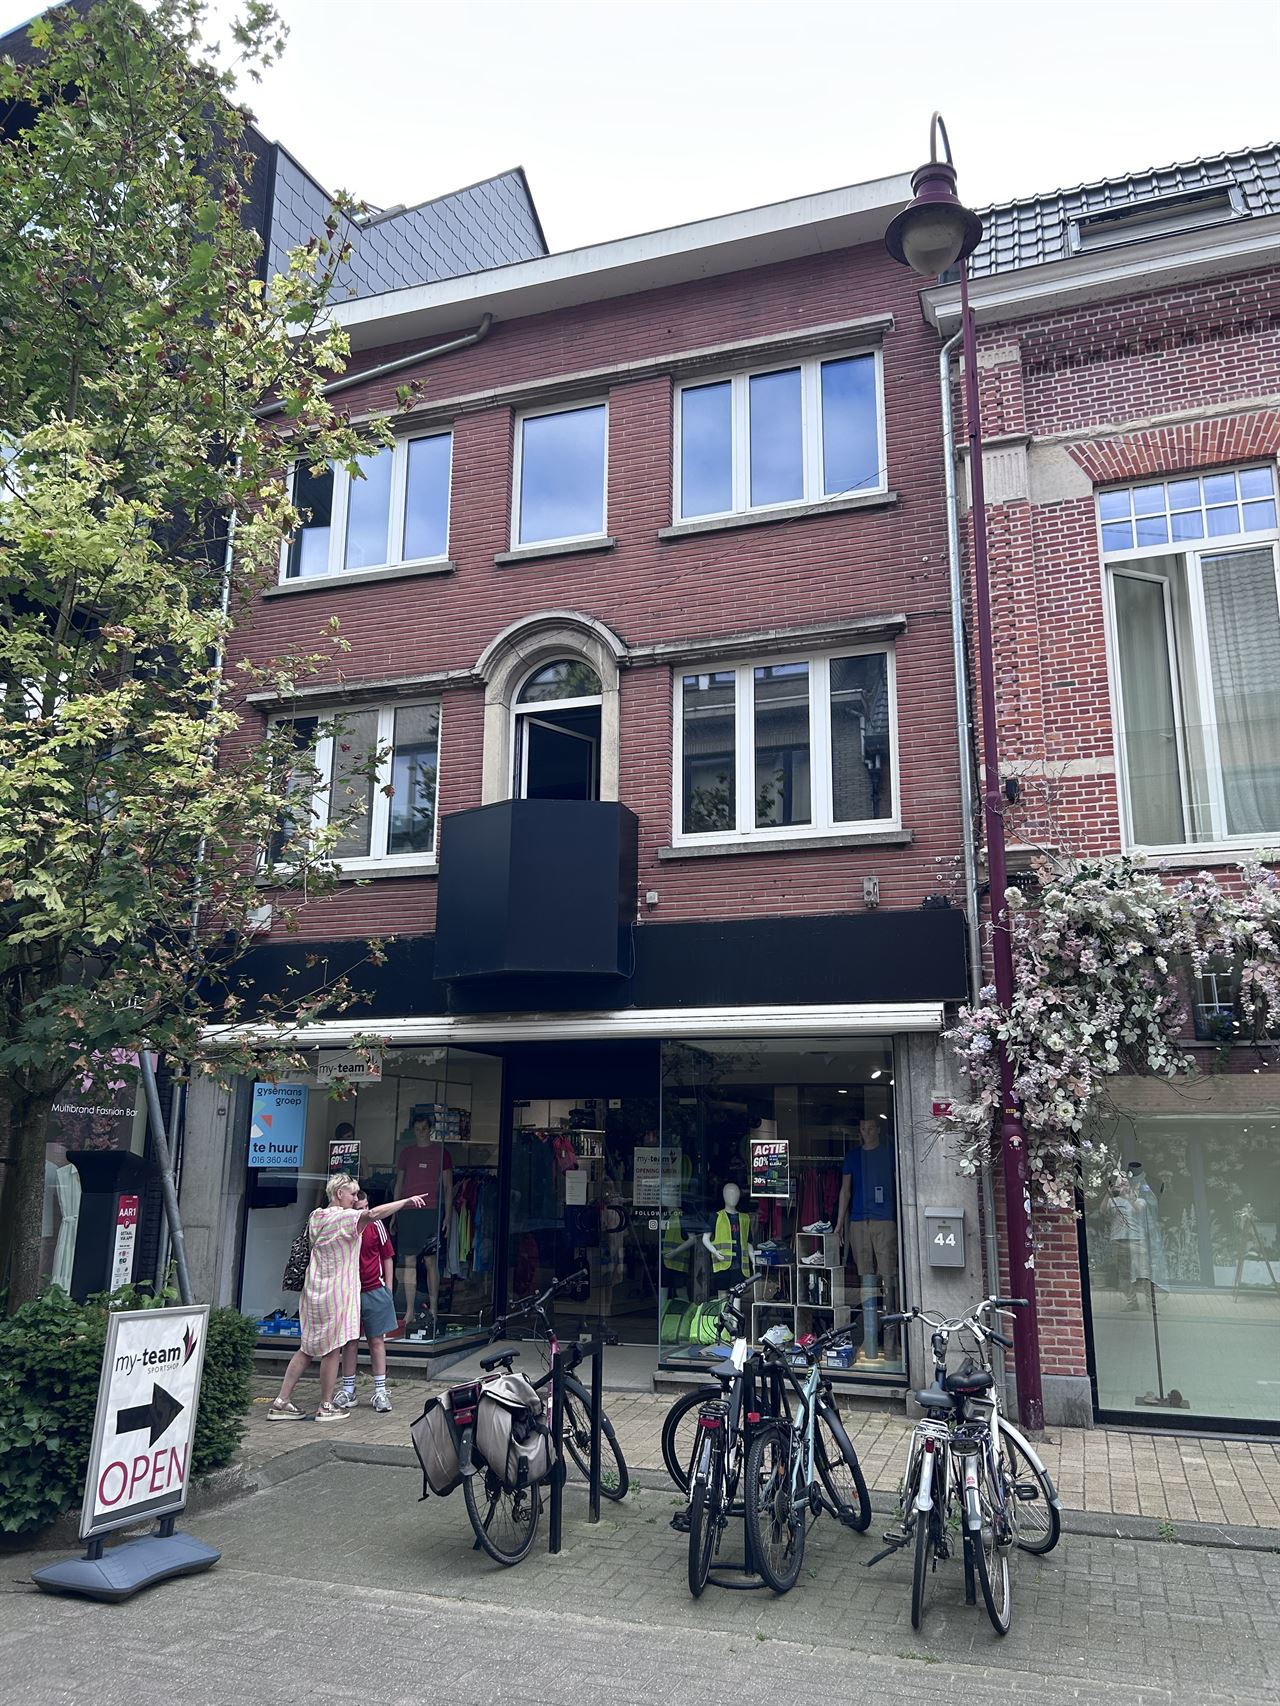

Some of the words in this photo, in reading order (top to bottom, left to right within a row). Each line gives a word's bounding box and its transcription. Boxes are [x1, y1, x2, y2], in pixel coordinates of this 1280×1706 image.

[320, 1064, 365, 1076] my-team
[257, 1087, 302, 1096] gysemans
[275, 1097, 302, 1106] groep
[51, 1103, 95, 1114] Multibrand
[126, 1108, 138, 1117] Bar
[253, 1142, 265, 1153] te
[269, 1142, 298, 1153] huur
[332, 1144, 358, 1155] ACTIE
[754, 1143, 786, 1155] ACTIE
[252, 1156, 265, 1164] 016
[266, 1156, 281, 1164] 360
[753, 1156, 769, 1167] 60%
[119, 1207, 136, 1217] AAR1
[934, 1233, 956, 1246] 44
[115, 1347, 181, 1376] my-team
[147, 1363, 179, 1375] SPORTSHOP
[99, 1442, 188, 1506] OPEN
